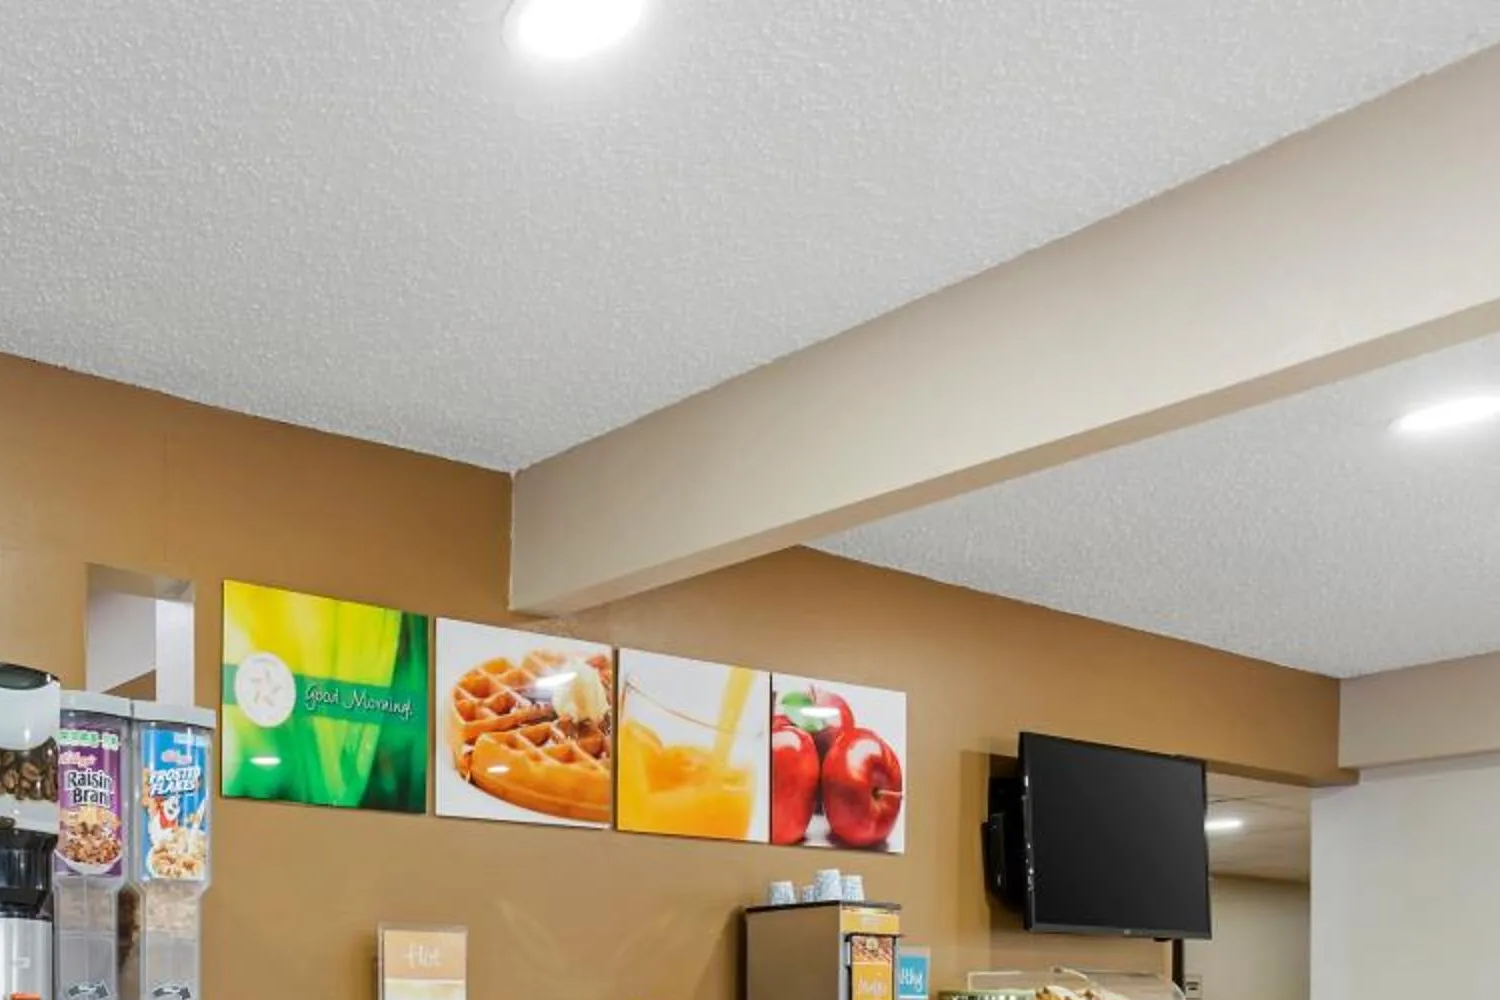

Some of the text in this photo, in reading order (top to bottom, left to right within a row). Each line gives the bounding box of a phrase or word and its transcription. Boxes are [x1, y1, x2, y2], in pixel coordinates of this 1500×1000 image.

[305, 683, 339, 711] Good
[67, 769, 113, 790] Raisin
[72, 787, 112, 806] Bran
